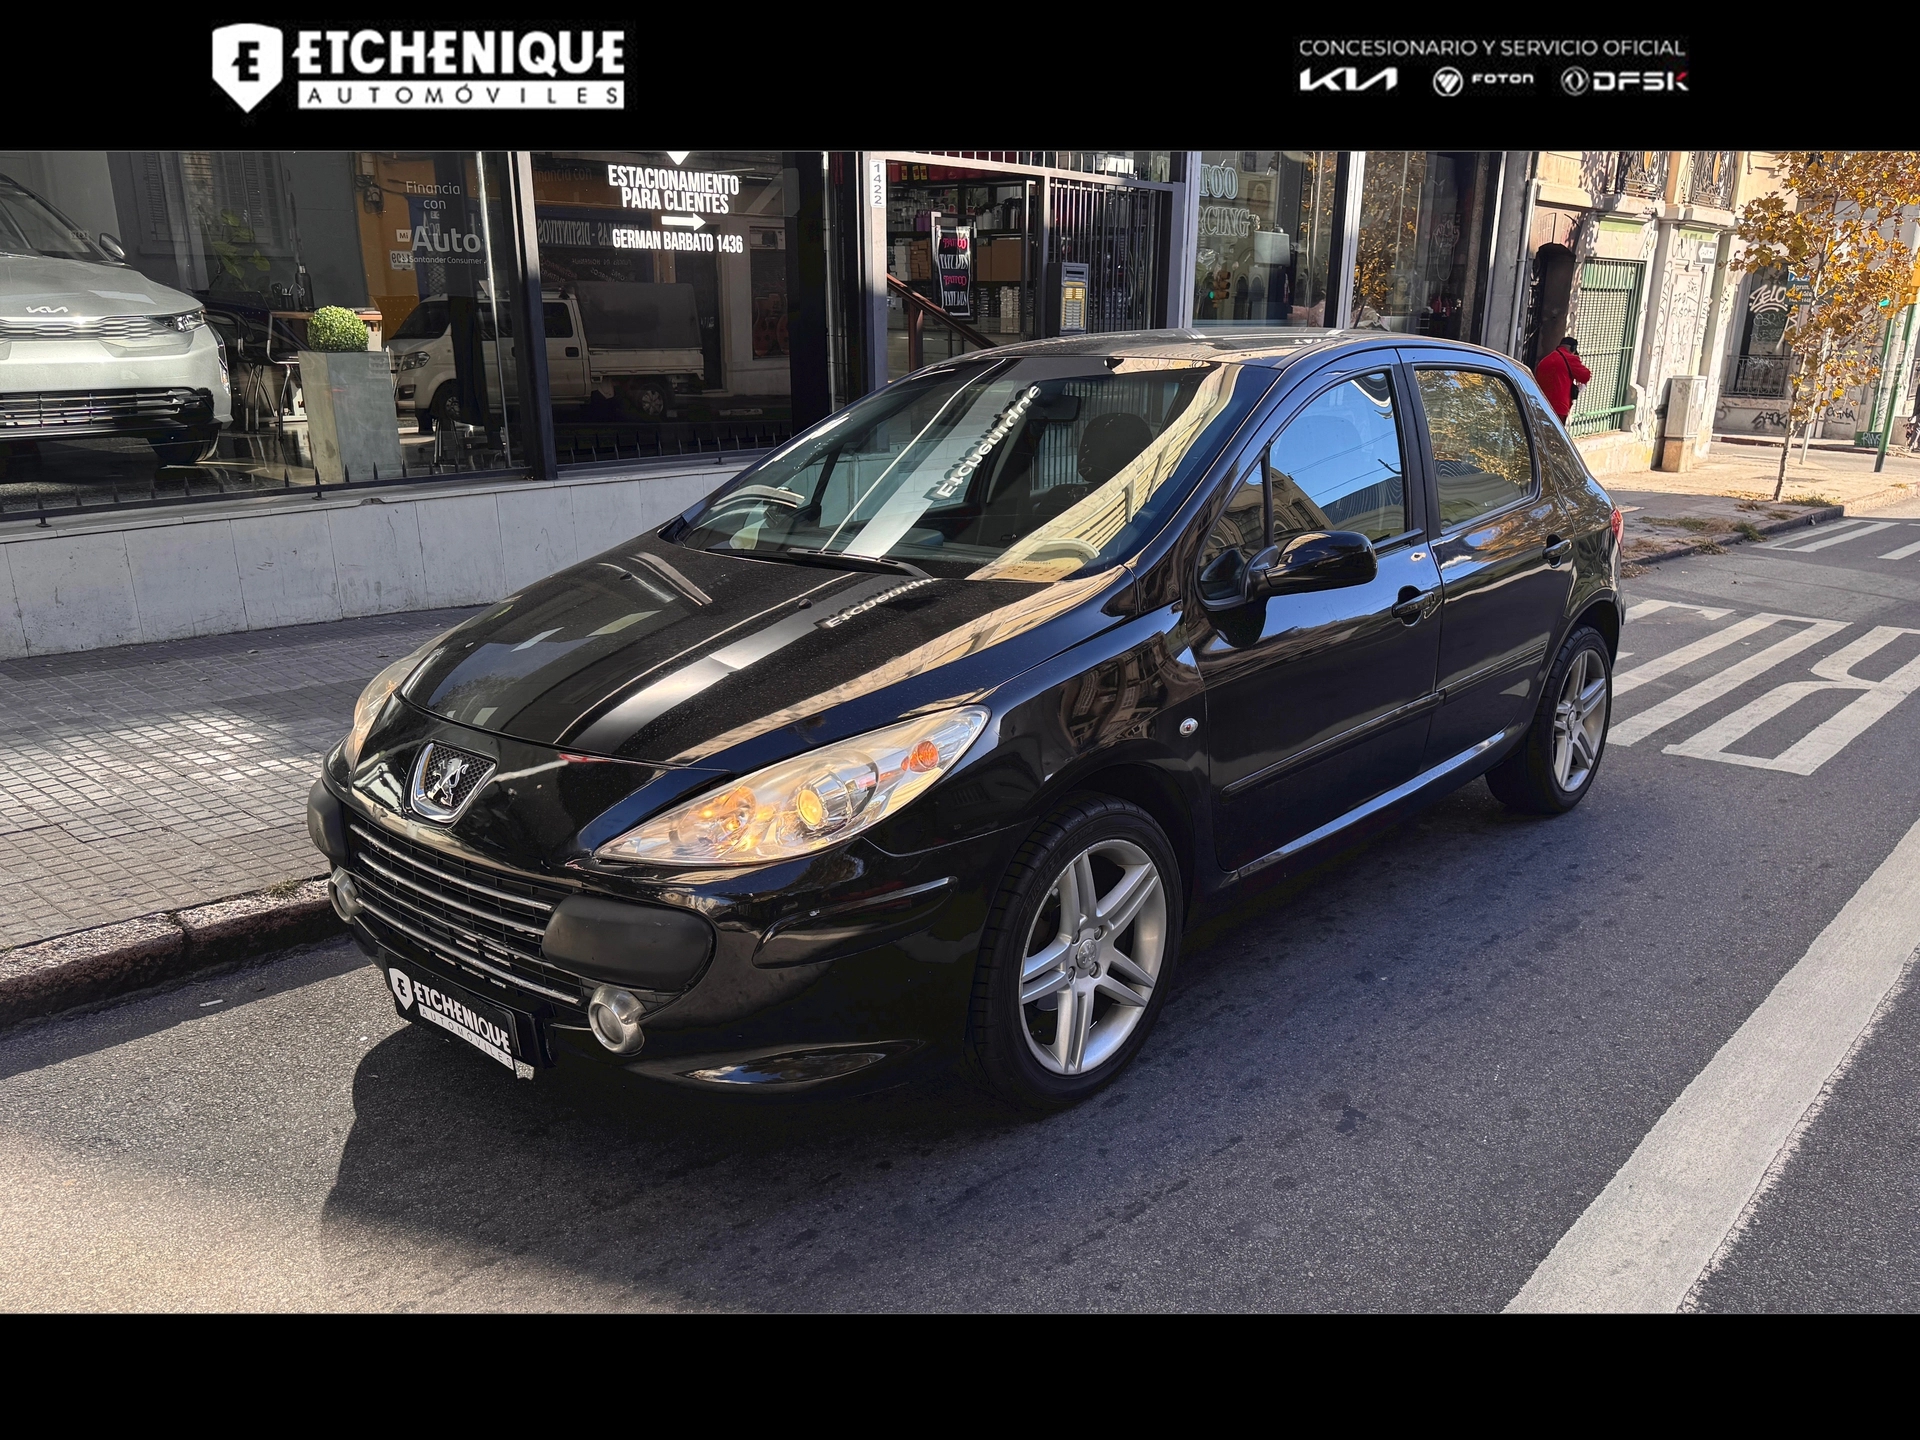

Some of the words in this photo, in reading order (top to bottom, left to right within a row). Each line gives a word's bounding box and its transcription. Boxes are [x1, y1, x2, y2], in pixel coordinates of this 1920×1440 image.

[405, 181, 461, 195] Financia
[607, 164, 740, 196] ESTACIONAMIENTO
[873, 163, 883, 205] 1422
[423, 199, 447, 210] con
[621, 186, 662, 211] PARA
[664, 189, 730, 214] CLIENTES
[411, 225, 481, 253] Auto
[612, 228, 662, 250] GERMAN
[663, 231, 714, 253] BARBATO
[716, 234, 744, 254] 1436
[409, 255, 447, 264] Santander
[447, 256, 482, 265] Consumer
[413, 980, 512, 1055] ETCHENIQUE
